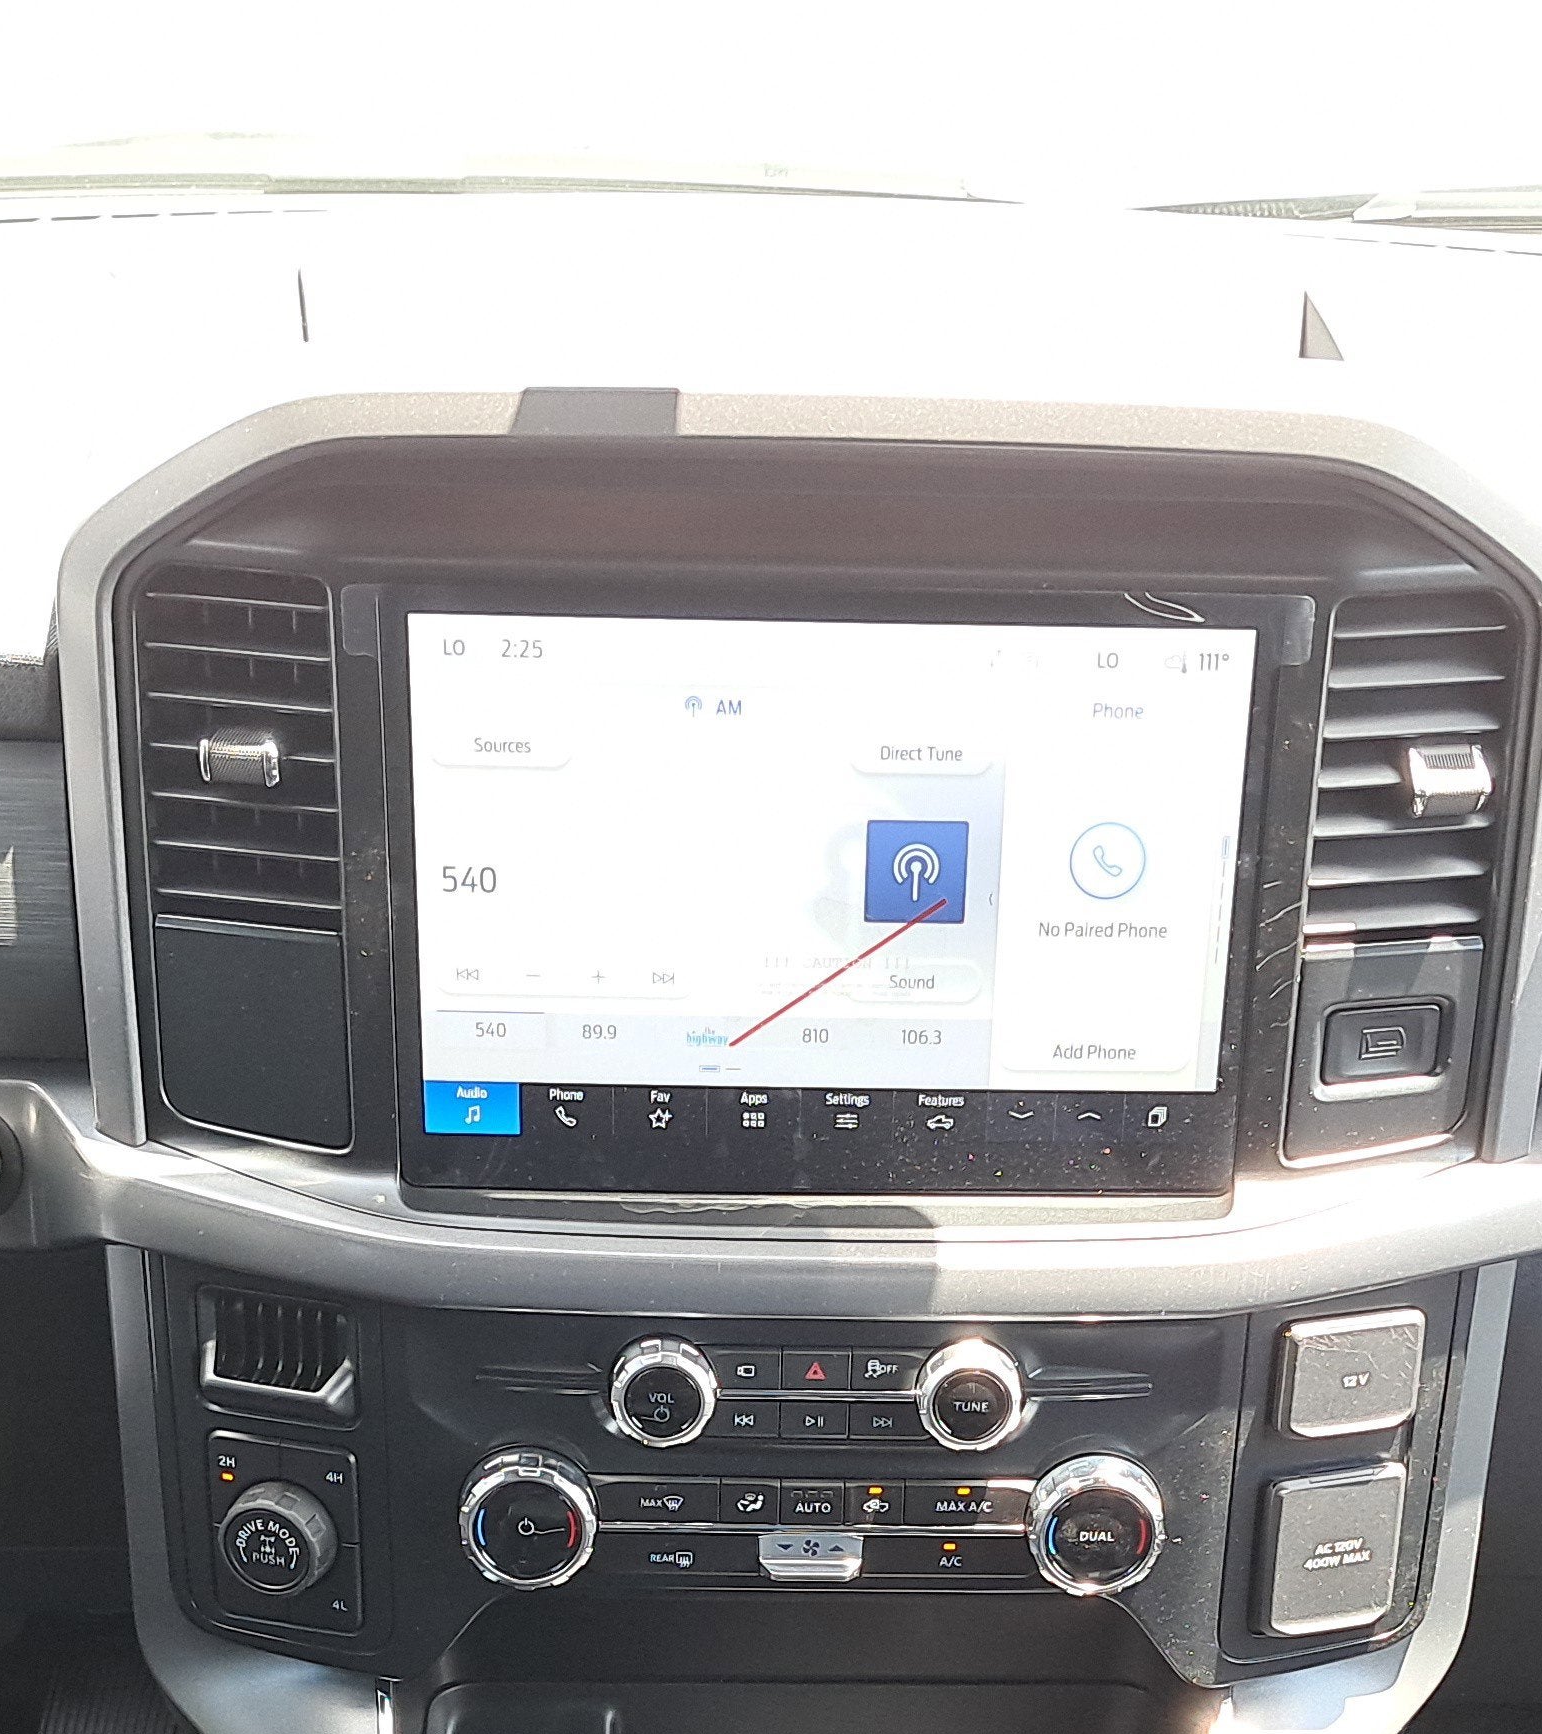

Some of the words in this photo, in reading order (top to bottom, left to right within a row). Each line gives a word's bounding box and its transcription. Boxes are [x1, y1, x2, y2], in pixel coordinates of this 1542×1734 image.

[443, 639, 466, 656] LO
[501, 640, 543, 658] 2:25
[1097, 652, 1119, 669] LO
[716, 699, 742, 716] AM
[1093, 702, 1144, 720] Phone
[474, 737, 531, 754] Sources
[880, 745, 922, 761] Direct
[928, 746, 963, 762] Tune
[442, 866, 497, 893] 540
[1039, 922, 1060, 938] No
[1064, 922, 1114, 939] Paired
[1117, 923, 1167, 939] Phone
[889, 974, 935, 990] Sound
[475, 1022, 507, 1038] 540
[581, 1023, 617, 1040] 89.9
[802, 1028, 829, 1044] 810
[901, 1029, 942, 1045] 106.3
[1053, 1045, 1084, 1061] Add
[1087, 1045, 1136, 1061] Phone
[456, 1087, 487, 1100] Audio
[549, 1088, 584, 1102] Phone
[650, 1090, 670, 1104] Fav
[740, 1091, 768, 1106] Apps
[825, 1092, 869, 1107] Settings
[918, 1093, 964, 1108] Features
[881, 1363, 899, 1375] OFF
[649, 1393, 674, 1403] VOL
[953, 1401, 989, 1413] TUNE
[218, 1456, 235, 1468] 2H
[326, 1472, 343, 1484] 4H
[640, 1497, 662, 1508] MAX
[795, 1502, 831, 1513] AUTO
[935, 1502, 966, 1512] MAX
[968, 1501, 993, 1513] A/C
[236, 1519, 265, 1548] DRIVE
[268, 1520, 299, 1555] MODE
[1079, 1531, 1114, 1542] DUAL
[253, 1552, 285, 1567] PUSH
[650, 1553, 674, 1564] REAR
[939, 1556, 962, 1567] A/C
[1343, 1549, 1371, 1564] MAX
[332, 1600, 347, 1611] 4L
